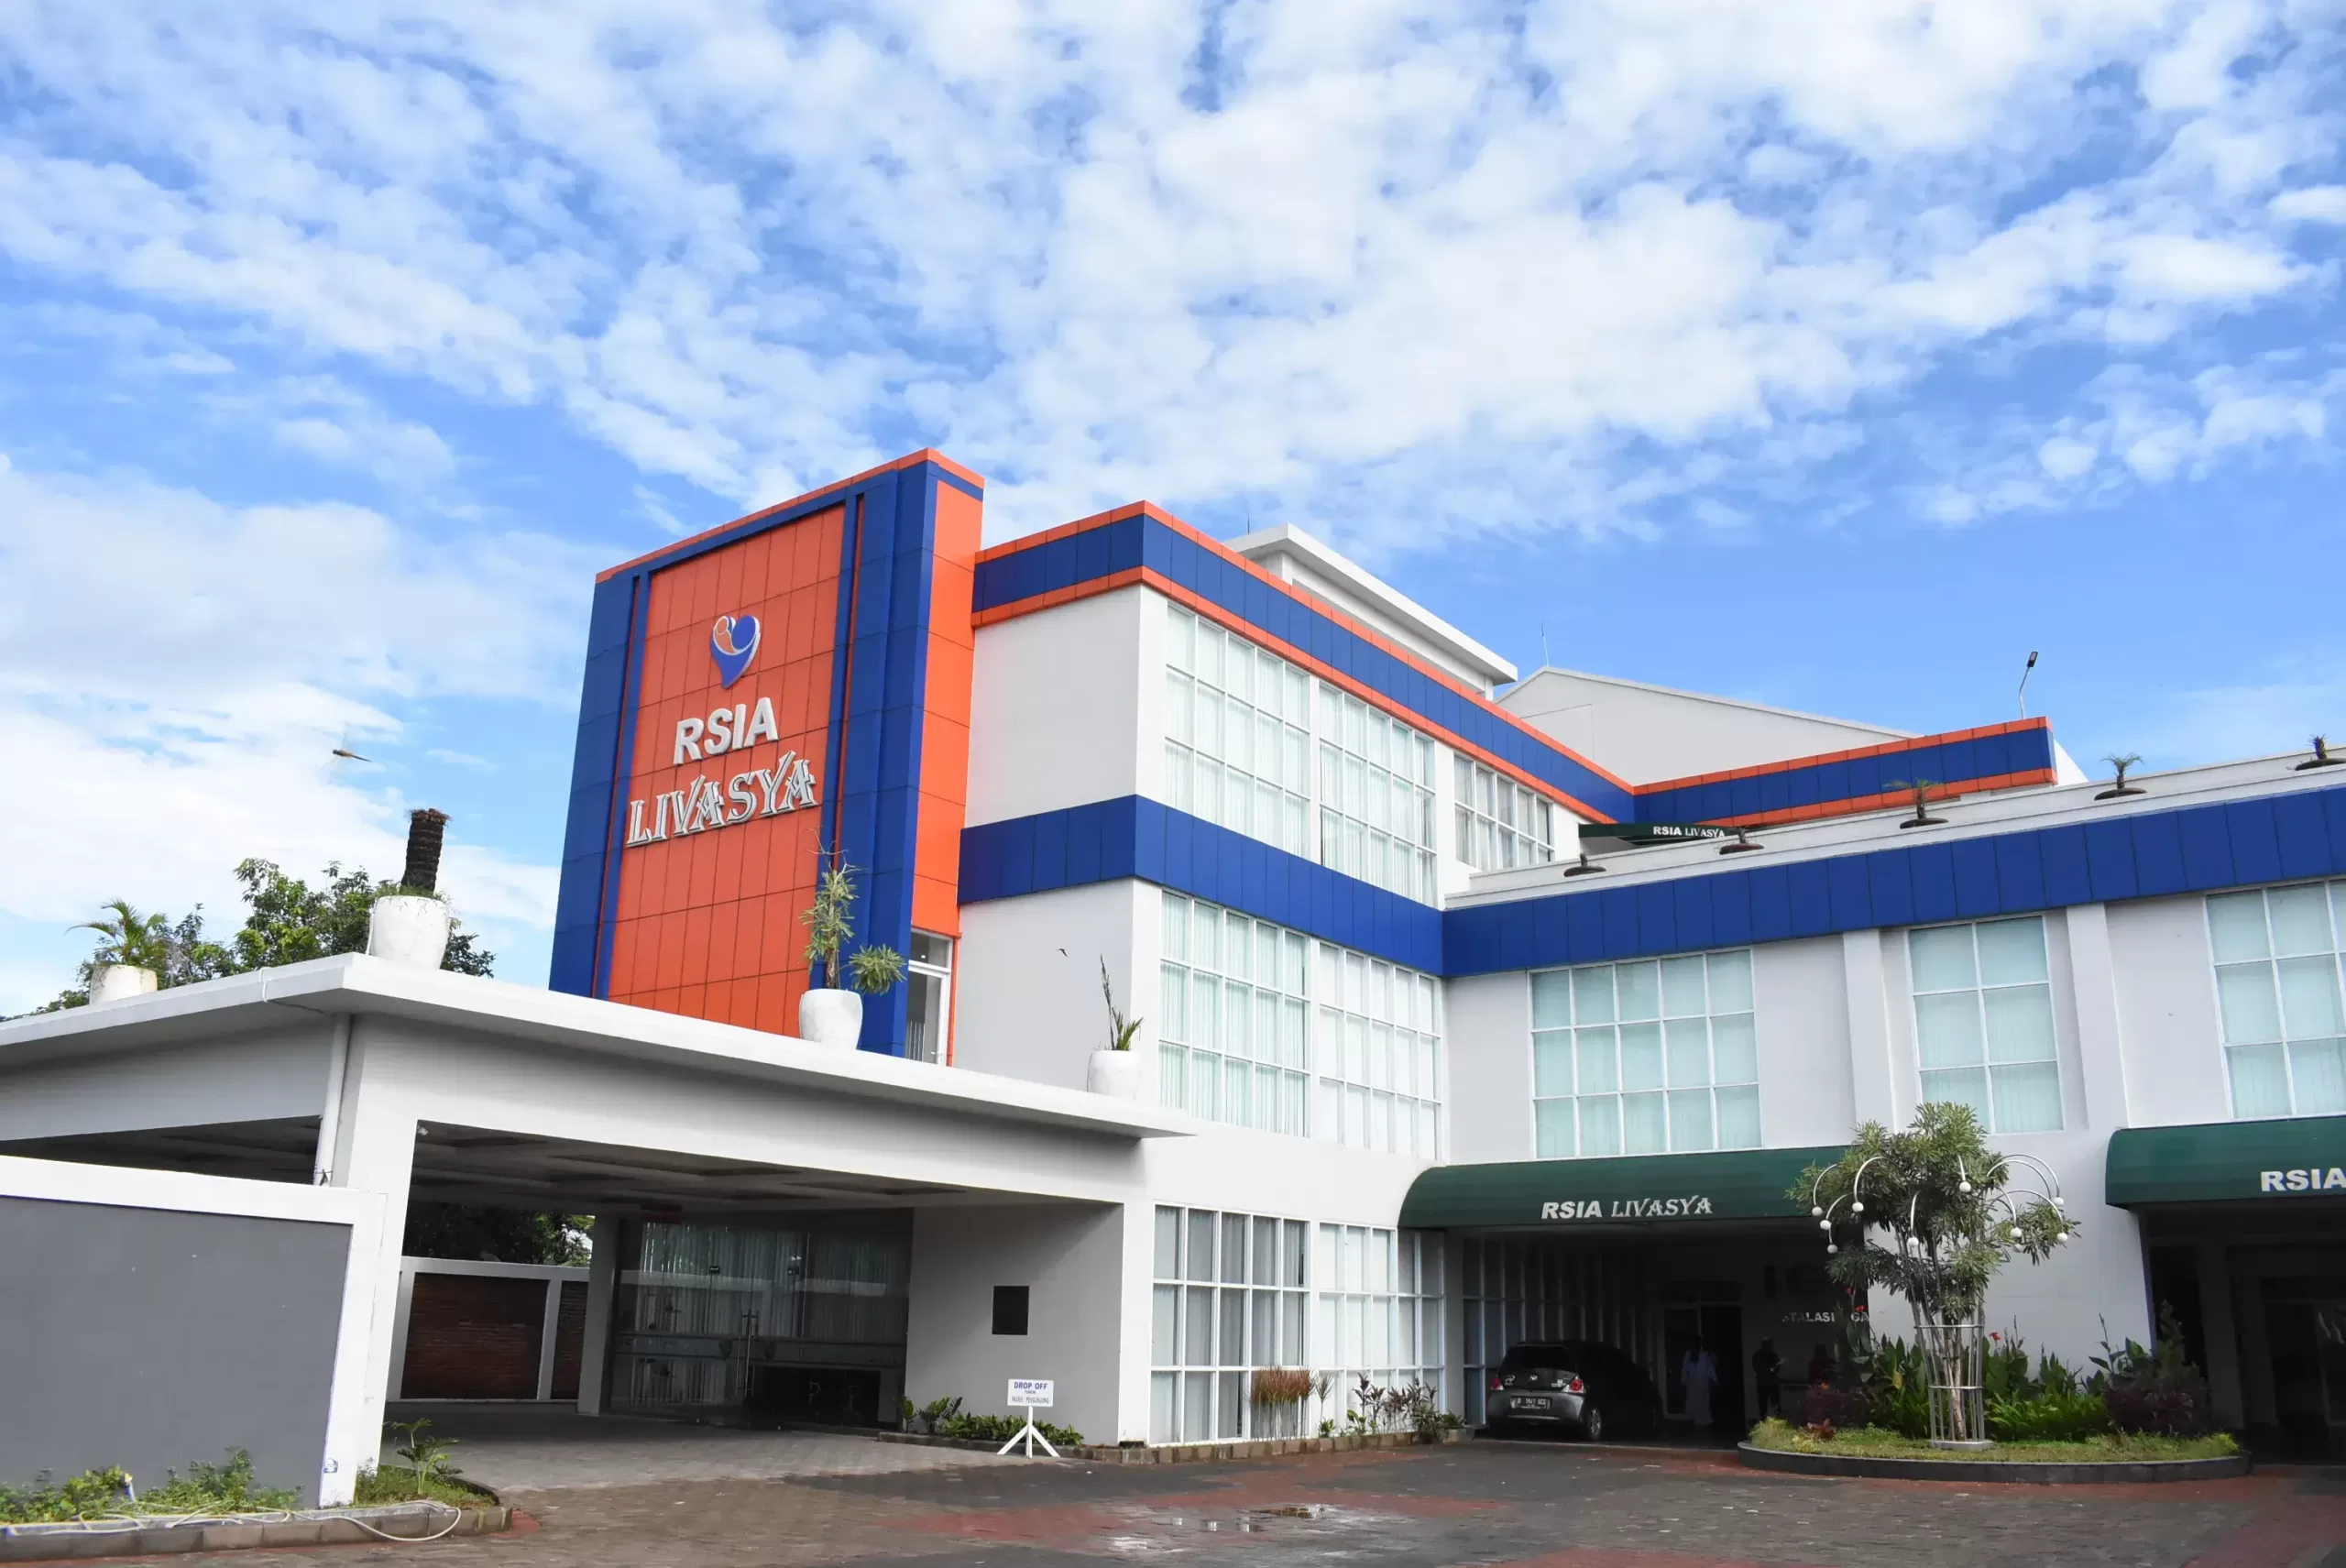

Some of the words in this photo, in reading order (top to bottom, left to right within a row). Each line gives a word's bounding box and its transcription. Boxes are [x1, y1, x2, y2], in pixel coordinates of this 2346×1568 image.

[674, 697, 779, 765] RSIA
[626, 750, 818, 848] LIVASYA
[1653, 826, 1682, 836] RSIA
[1684, 827, 1725, 838] LIVASYA
[2261, 1168, 2346, 1191] RSIA
[1541, 1201, 1603, 1219] RSIA
[1611, 1195, 1713, 1218] LIVASYA
